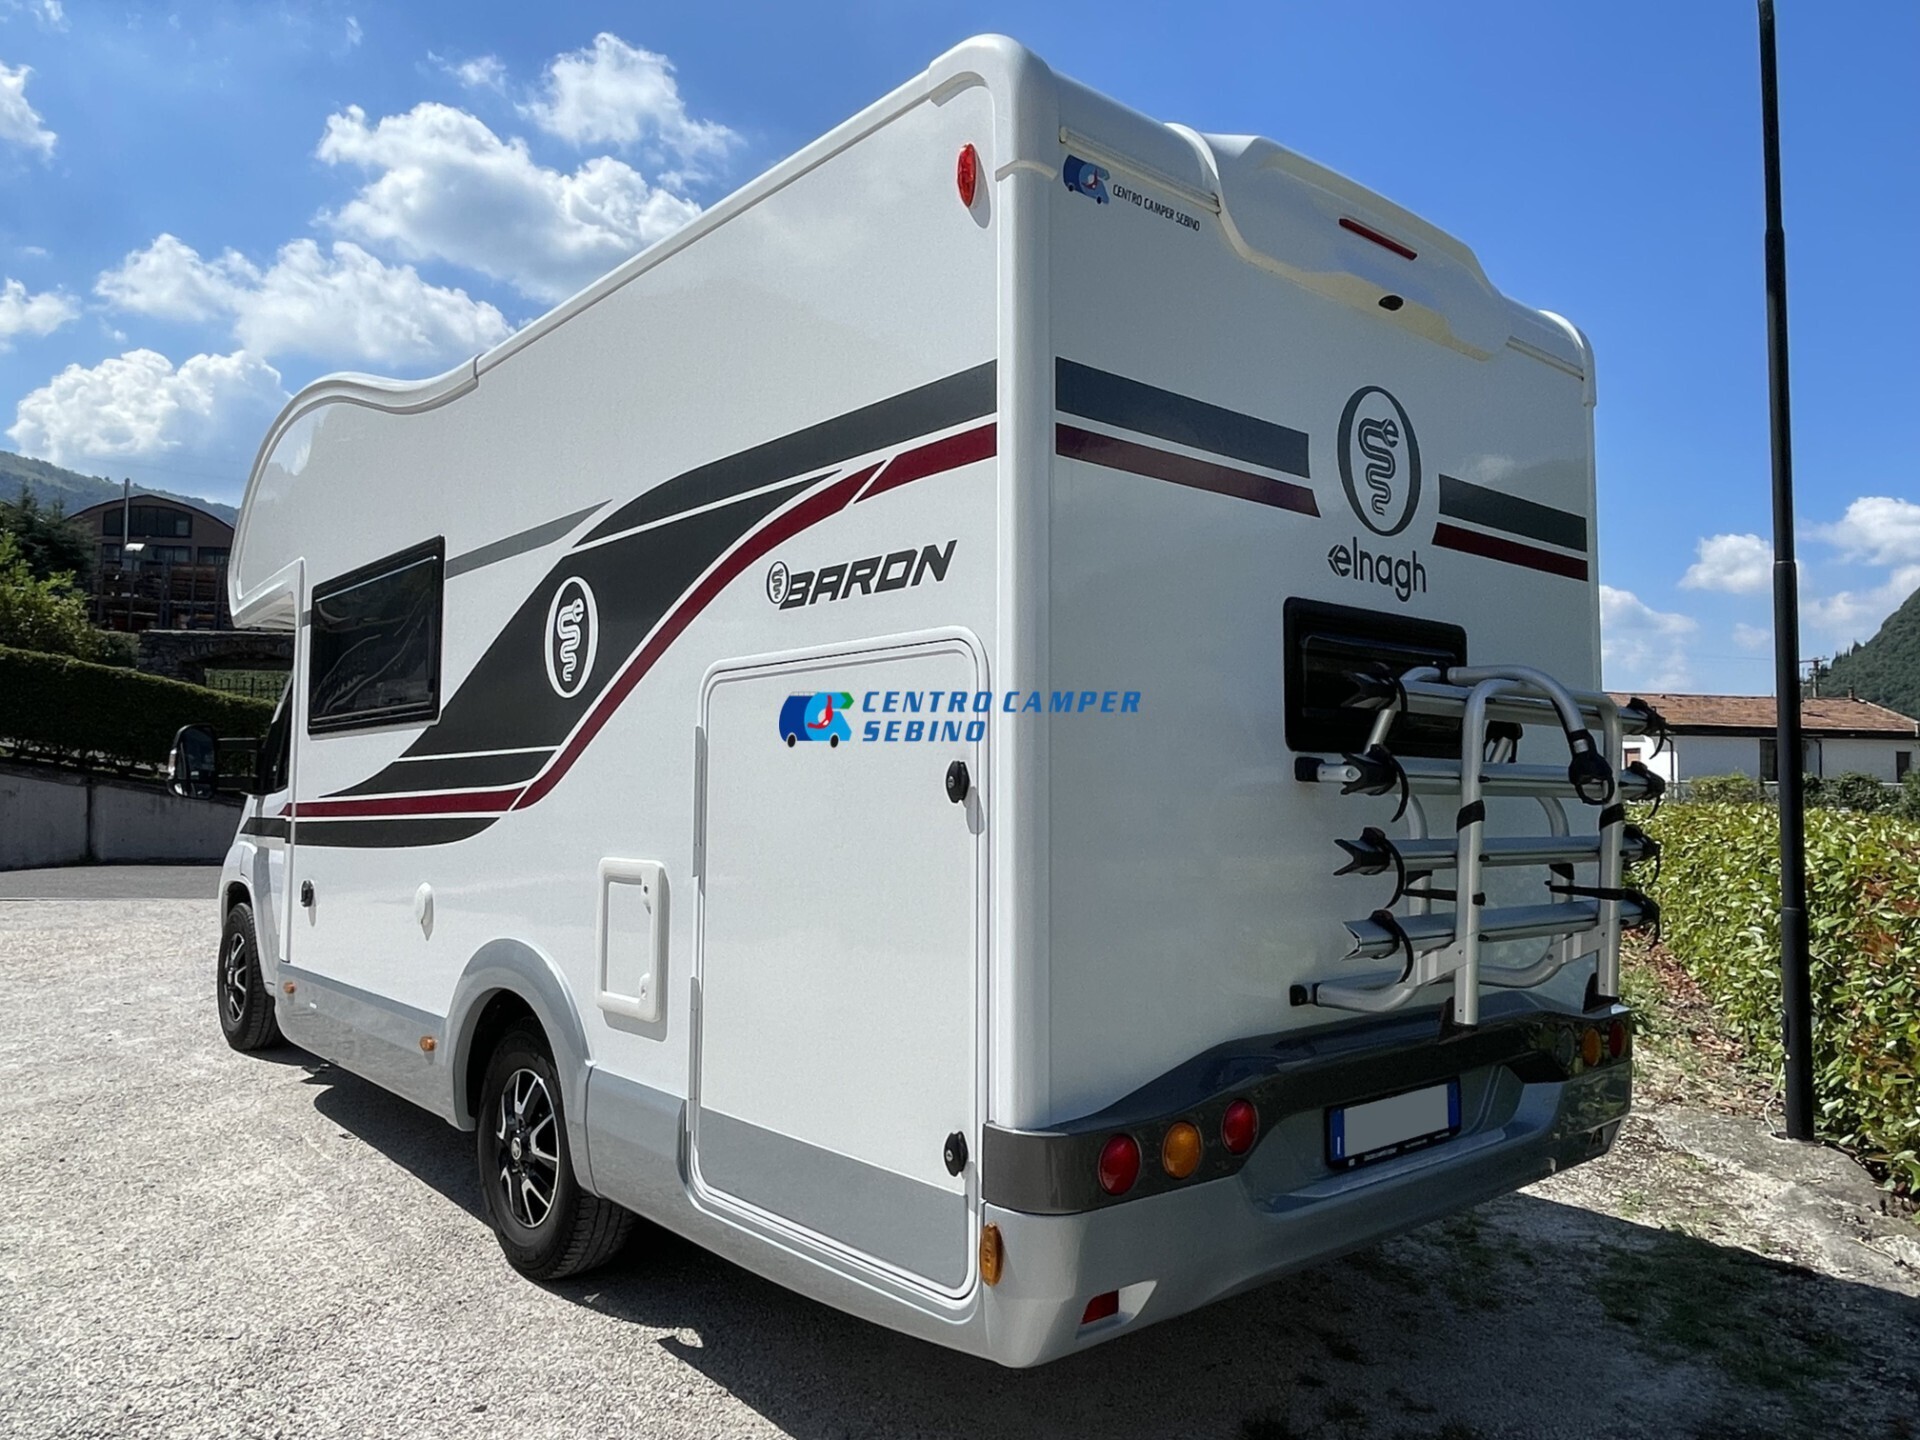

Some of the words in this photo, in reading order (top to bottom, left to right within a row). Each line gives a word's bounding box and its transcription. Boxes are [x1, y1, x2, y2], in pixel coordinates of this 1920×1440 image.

[1112, 184, 1143, 206] CENTRO
[1144, 198, 1174, 220] CAMPER
[1175, 212, 1200, 232] SEBINO
[778, 539, 958, 610] BARON
[1327, 536, 1427, 603] elnagh
